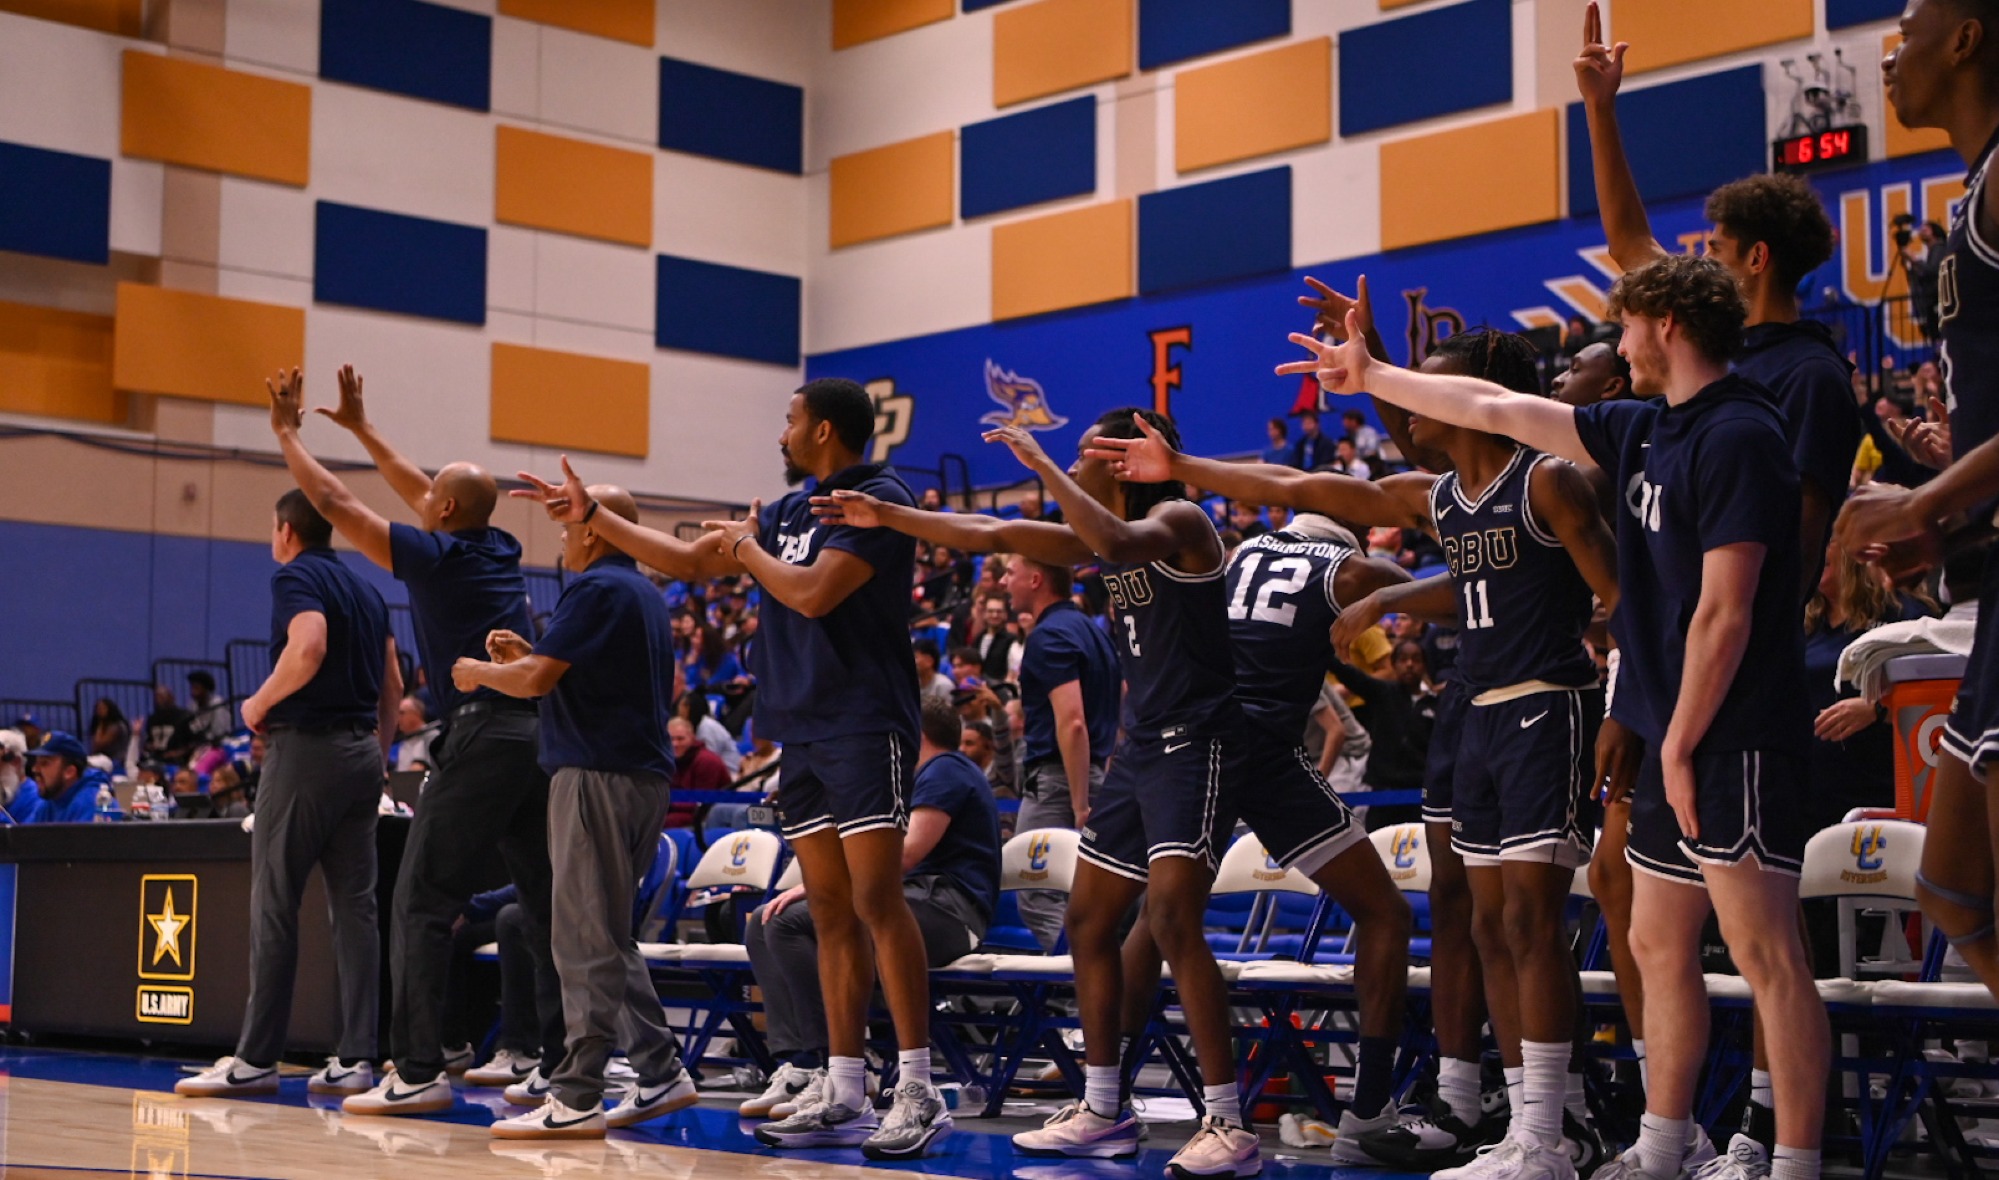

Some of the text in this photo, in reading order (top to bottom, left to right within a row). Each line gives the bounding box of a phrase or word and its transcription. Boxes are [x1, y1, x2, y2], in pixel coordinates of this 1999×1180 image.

[1443, 526, 1518, 577] CBU
[1102, 567, 1154, 610] BU
[1227, 552, 1313, 627] 12
[1463, 579, 1495, 630] 11
[1123, 615, 1142, 657] 2
[1850, 824, 1887, 870] UC
[1840, 868, 1888, 885] RIVERSIDE
